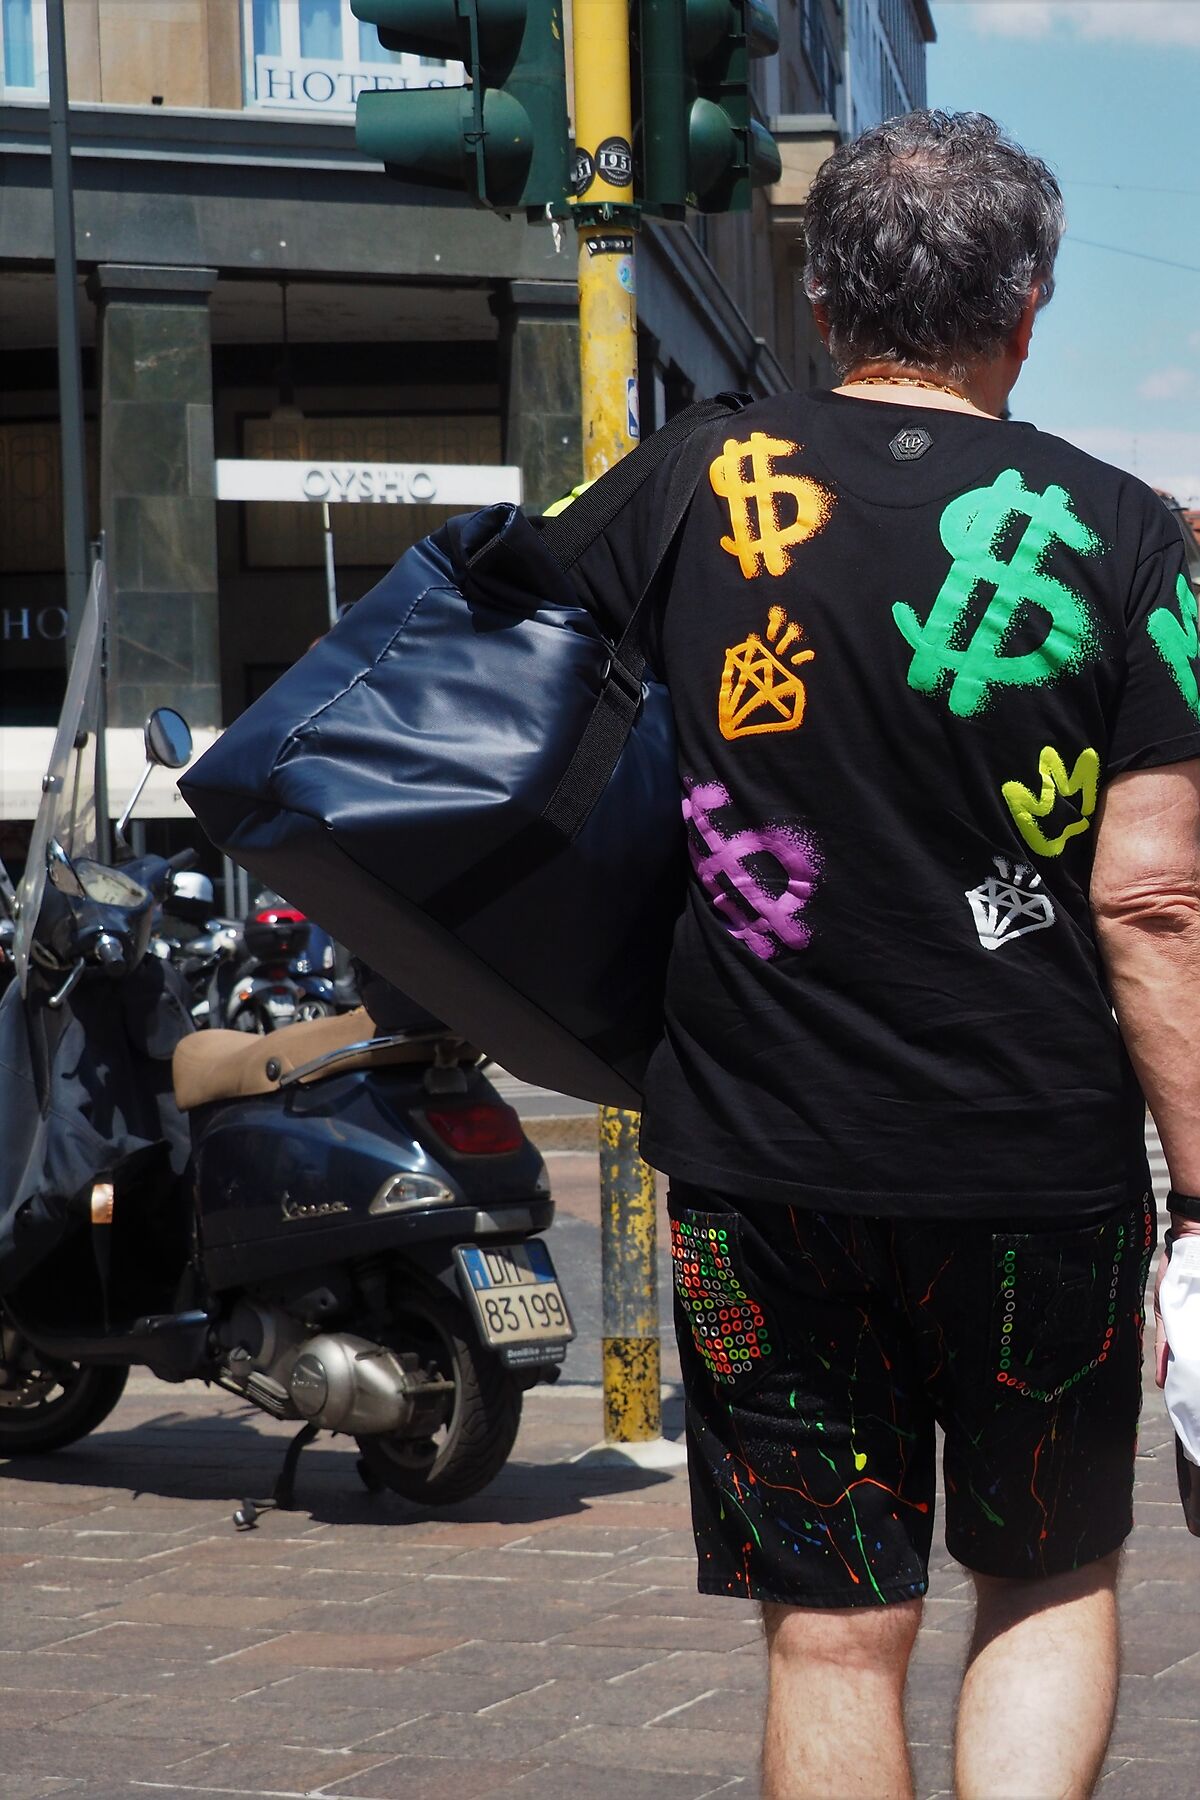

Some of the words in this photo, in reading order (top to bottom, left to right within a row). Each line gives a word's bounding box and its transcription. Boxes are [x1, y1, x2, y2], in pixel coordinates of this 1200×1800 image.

[263, 69, 446, 102] HOT
[303, 470, 437, 503] OYSHO
[485, 1292, 566, 1334] 83199
